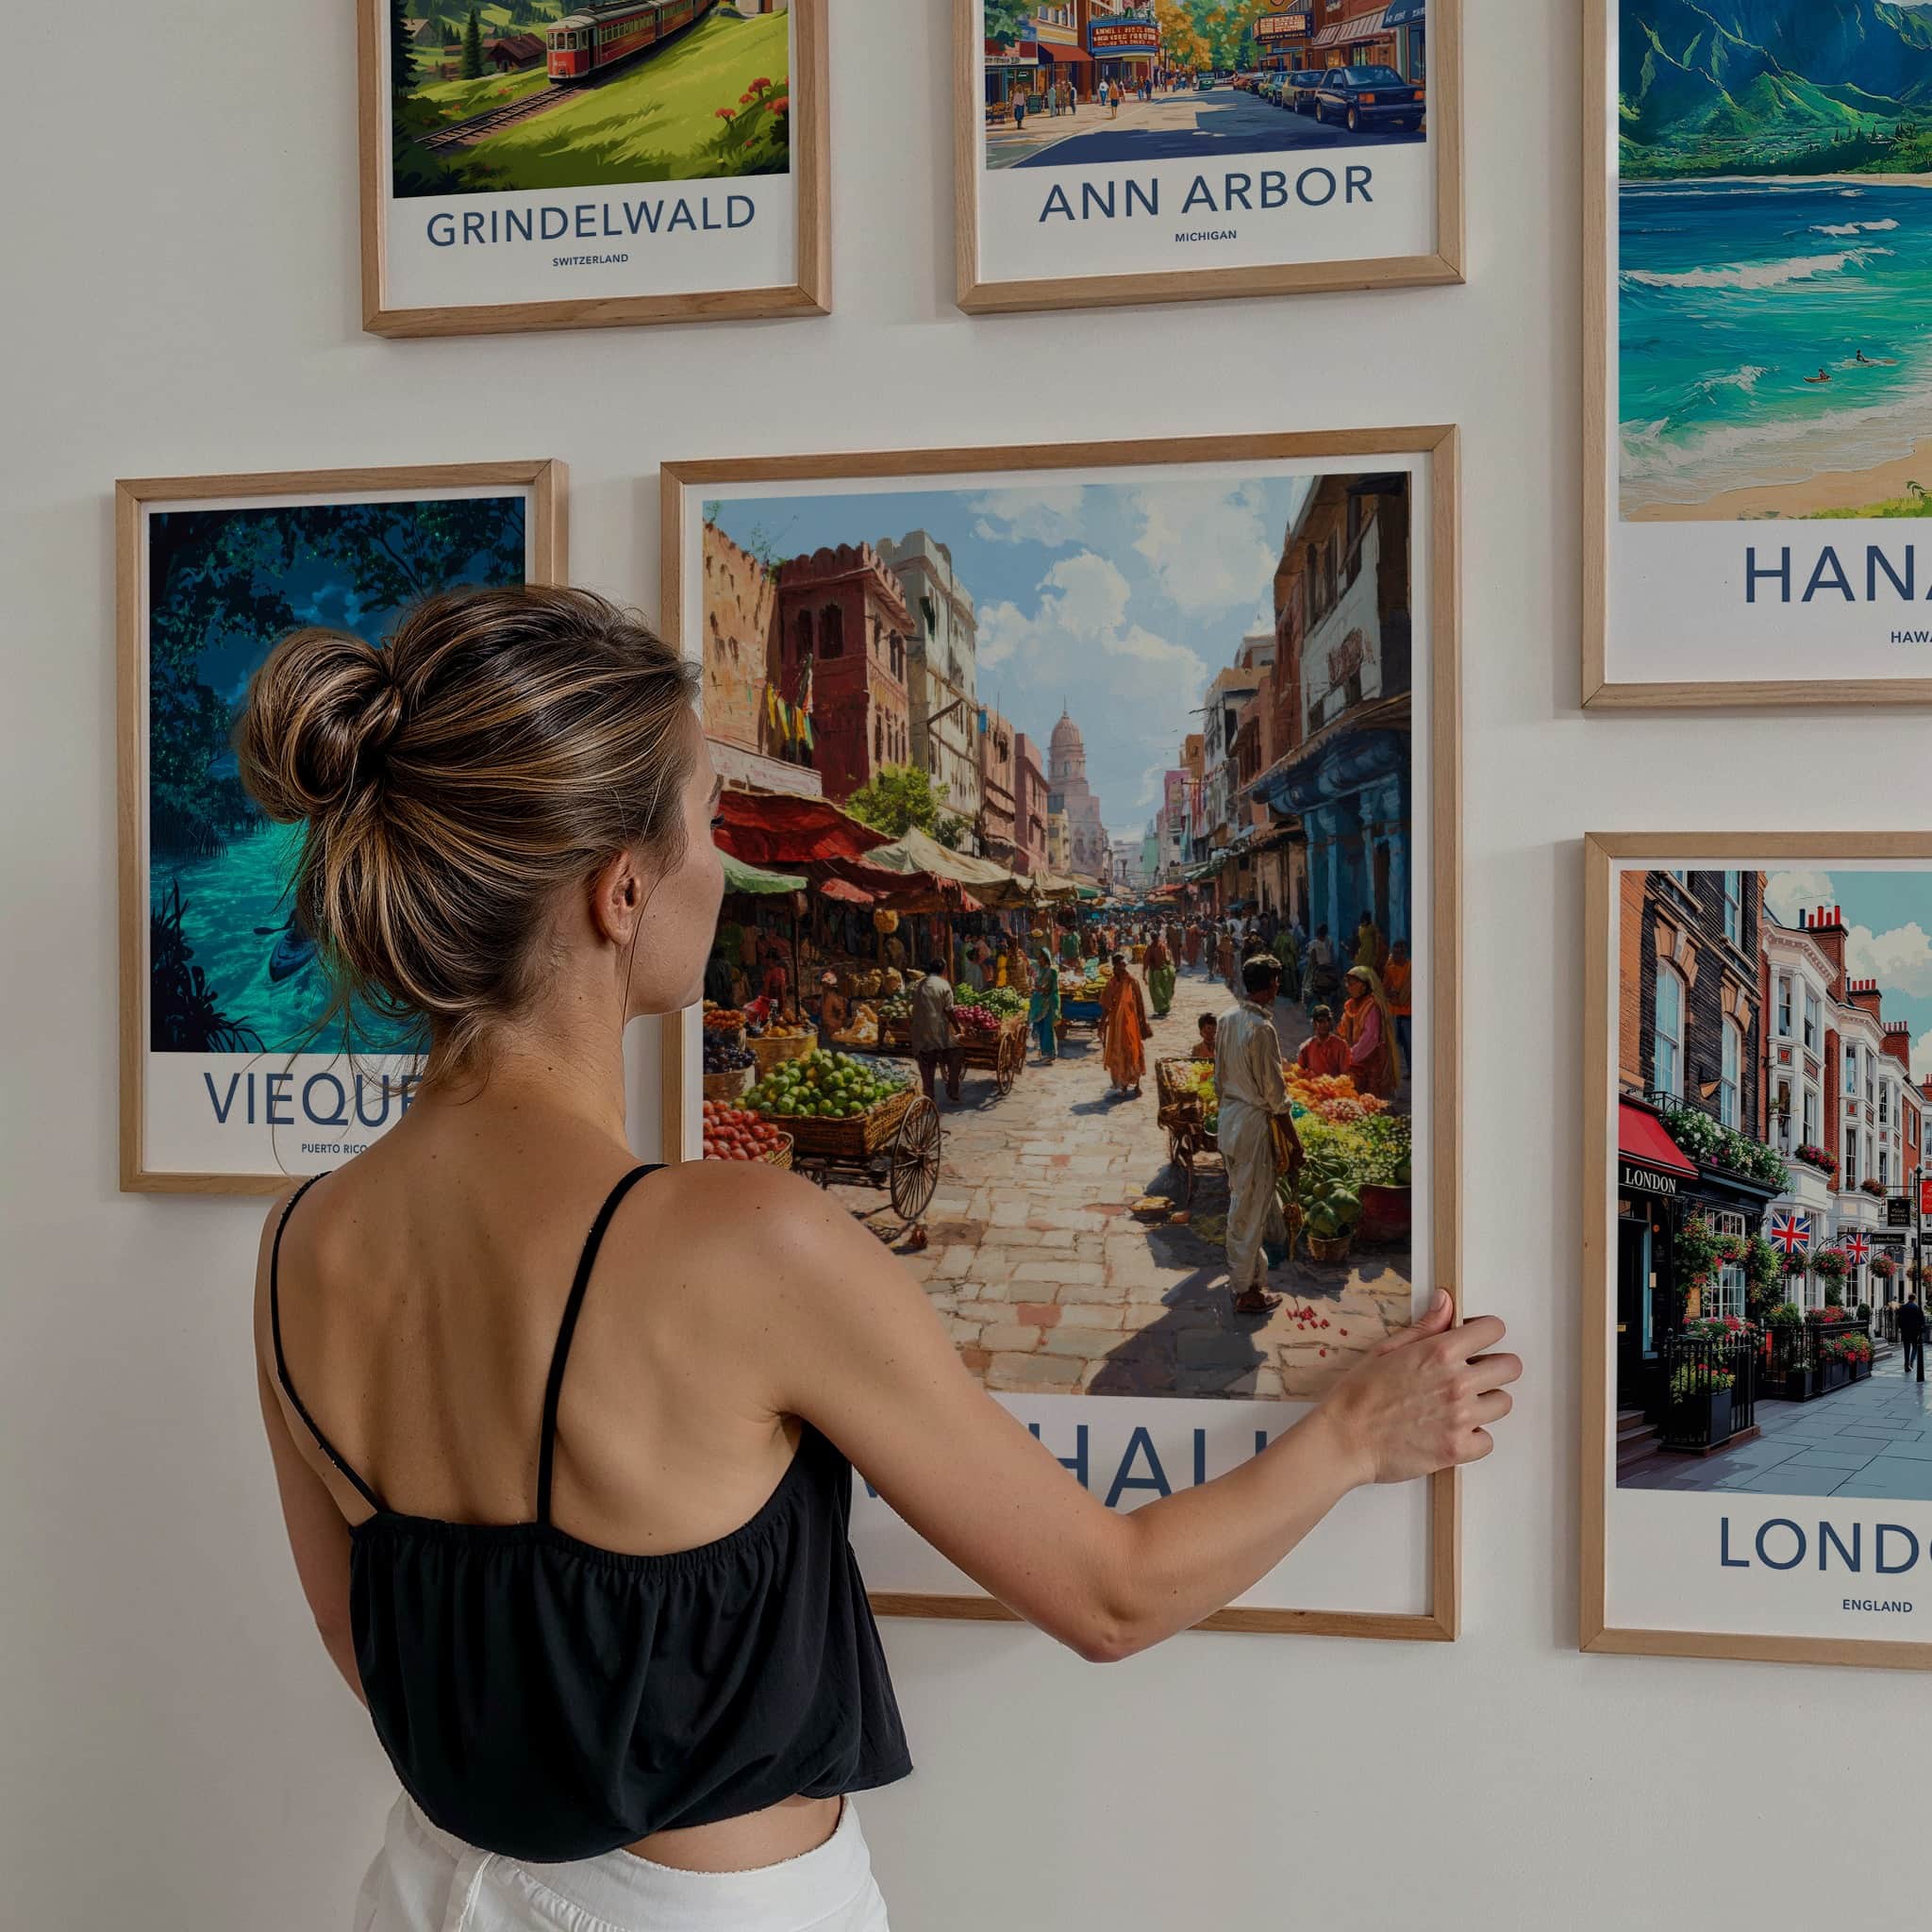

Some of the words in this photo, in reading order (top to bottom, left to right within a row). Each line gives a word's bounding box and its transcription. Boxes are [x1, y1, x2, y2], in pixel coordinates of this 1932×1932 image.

[1039, 177, 1159, 223] ANN
[1181, 165, 1374, 214] ARBOR
[426, 195, 756, 247] GRINDELWALD
[1174, 230, 1237, 242] MICHIGAN
[552, 254, 629, 267] SWITZERLAND
[1745, 544, 1932, 604] HAN
[1890, 630, 1932, 643] HAW
[204, 1072, 423, 1127] VIEQUE
[301, 1143, 341, 1154] PUERTO
[1624, 1167, 1676, 1194] LONDON
[1721, 1516, 1932, 1574] LOND
[1842, 1599, 1913, 1613] ENGLAND
